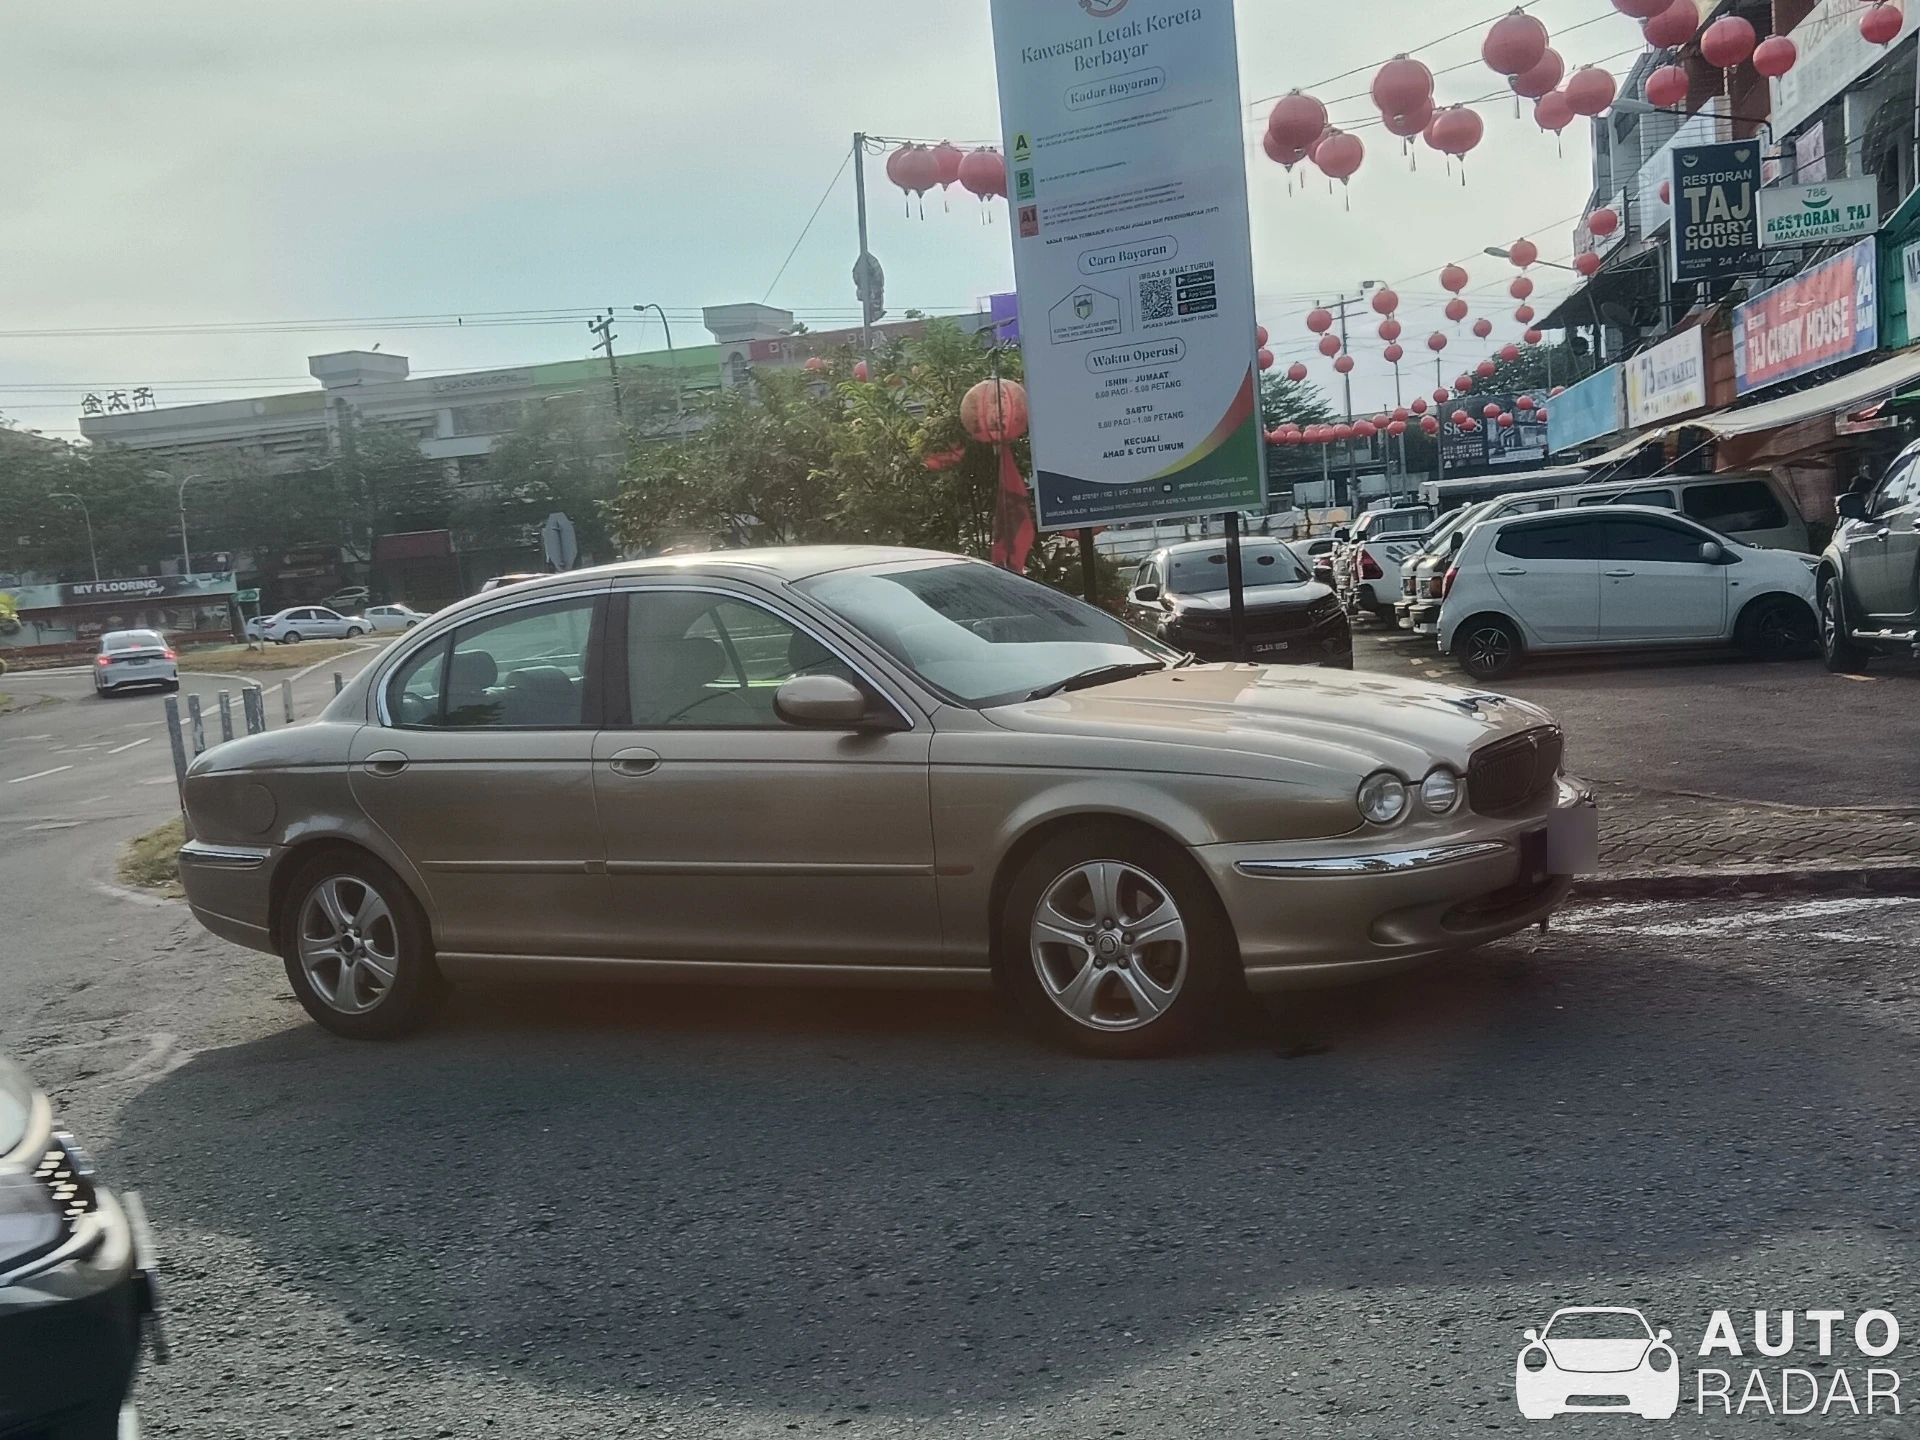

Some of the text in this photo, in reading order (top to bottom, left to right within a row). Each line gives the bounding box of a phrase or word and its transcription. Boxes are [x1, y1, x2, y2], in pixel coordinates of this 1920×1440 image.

[1021, 7, 1202, 65] Kawasan Letak Kereta
[1074, 41, 1150, 72] Berbayar
[1070, 75, 1159, 104] Kadar Bayaran
[1015, 134, 1028, 151] A
[1018, 172, 1031, 188] B
[1682, 168, 1753, 187] RESTORAN
[1683, 181, 1751, 224] TAJ
[1806, 187, 1828, 199] 786
[1766, 203, 1872, 233] RESTORAN TAJ
[1685, 219, 1752, 239] CURRY
[1774, 220, 1866, 243] MAKANAN ISLAM
[1685, 232, 1754, 251] HOUSE
[1088, 243, 1167, 269] Cara Bayaran
[1718, 256, 1733, 267] 24
[1855, 261, 1873, 308] 24
[1748, 332, 1766, 373] TAJ
[1767, 314, 1805, 366] CURRY
[1806, 295, 1851, 352] HOUSE
[1093, 343, 1179, 368] Waktu Operasi
[1105, 376, 1128, 388] ISNIN
[1135, 371, 1170, 384] JUMAAT
[1111, 385, 1129, 397] PAGI
[1151, 379, 1182, 391] PETANG
[81, 386, 154, 415] 金太子
[1125, 404, 1154, 415] SABTU
[1113, 417, 1132, 428] PAGI
[1152, 410, 1184, 423] PETANG
[1124, 434, 1161, 447] KECUALI
[1102, 448, 1126, 460] AHAD
[1135, 444, 1156, 456] CUTI
[1157, 441, 1184, 454] UMUM
[73, 584, 93, 595] MY
[95, 579, 158, 593] FLOORING
